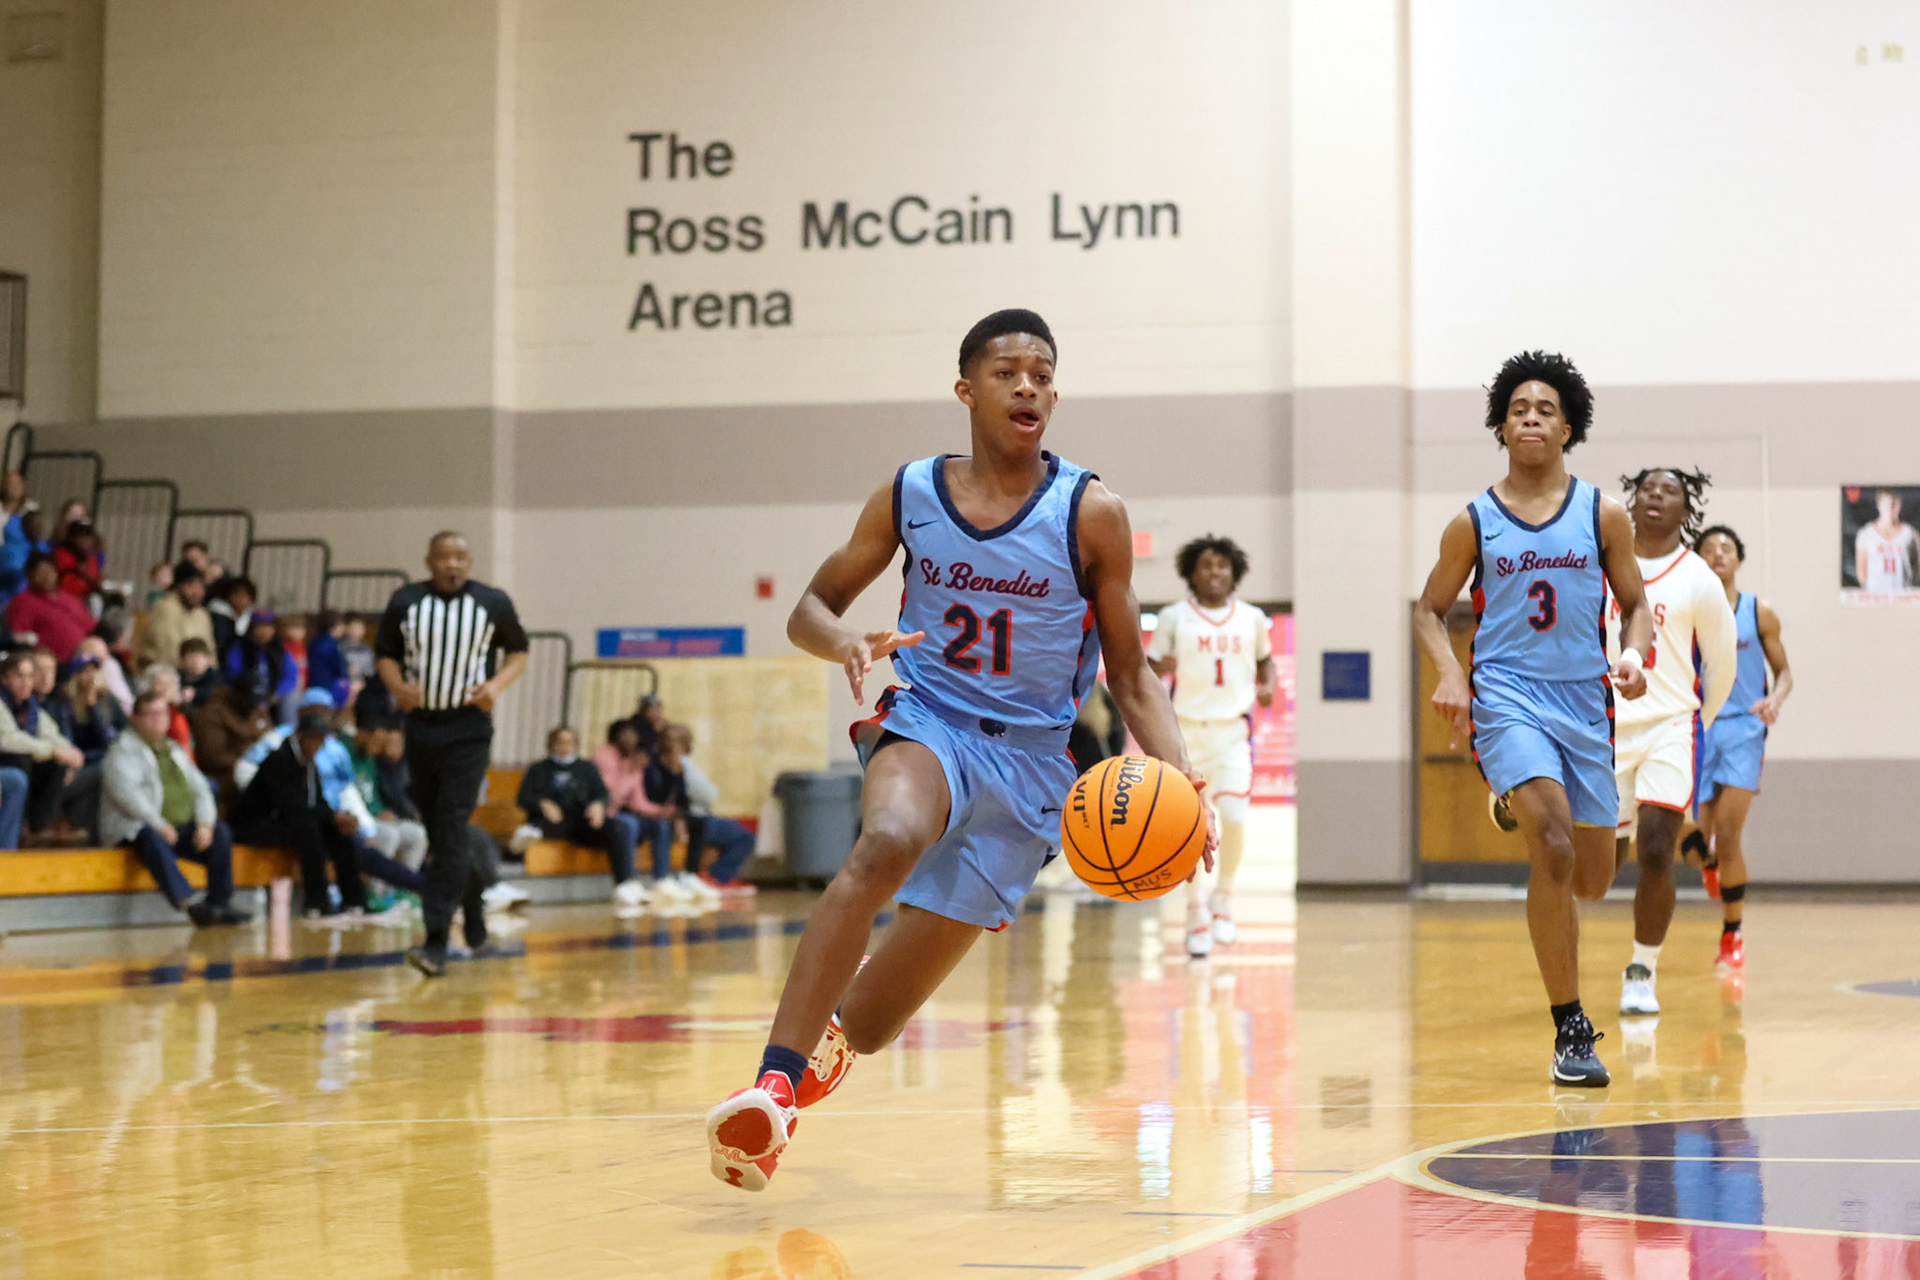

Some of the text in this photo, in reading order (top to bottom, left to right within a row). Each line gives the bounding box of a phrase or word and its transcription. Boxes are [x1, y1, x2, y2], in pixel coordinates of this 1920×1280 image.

[628, 132, 734, 181] The
[626, 192, 1180, 256] Ross McCain Lynn
[628, 281, 794, 331] Arena
[920, 557, 1050, 599] St Benedict
[1496, 548, 1588, 578] St Benedict
[1526, 579, 1557, 633] 3
[942, 602, 1013, 676] 21
[1197, 634, 1242, 655] MUS
[1214, 657, 1224, 687] 1
[1133, 868, 1173, 890] MUS
